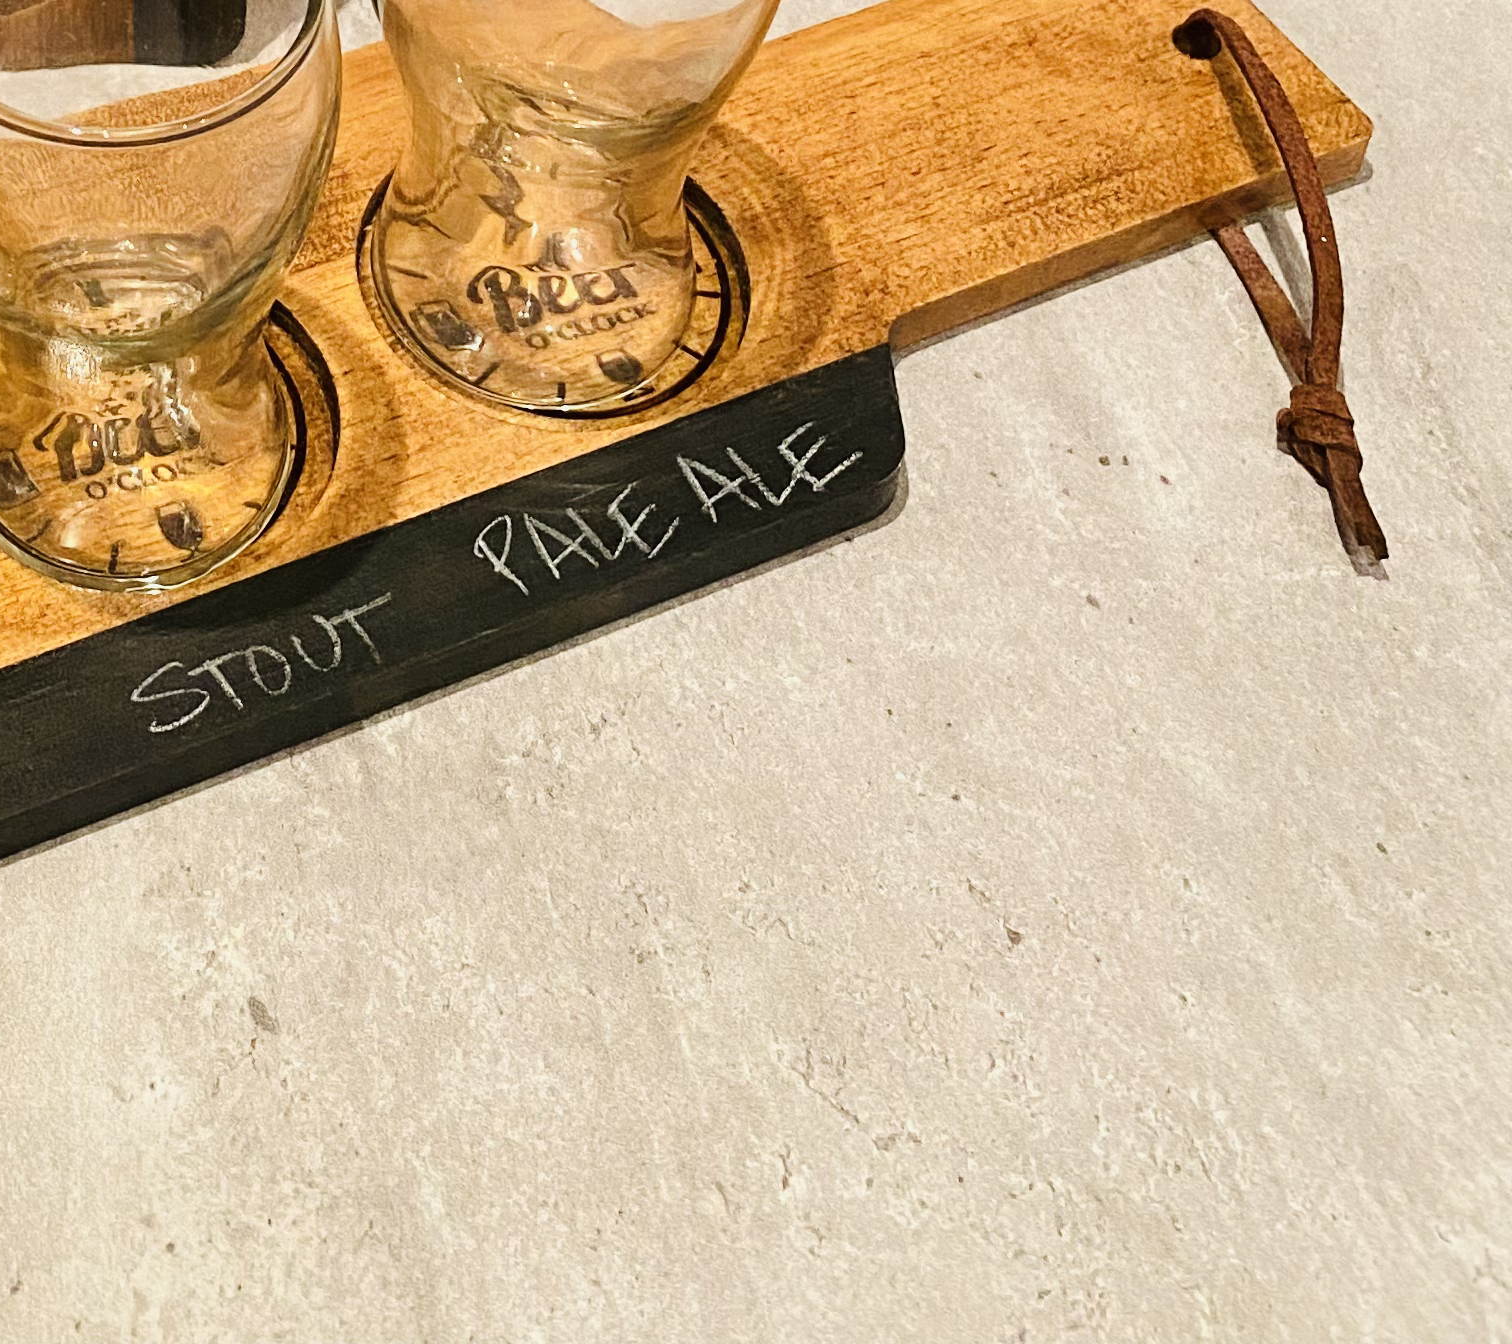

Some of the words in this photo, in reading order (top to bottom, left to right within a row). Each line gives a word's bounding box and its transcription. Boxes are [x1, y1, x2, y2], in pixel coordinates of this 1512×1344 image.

[473, 480, 680, 597] PALE
[676, 420, 864, 524] ALE
[130, 591, 392, 734] STOUT
